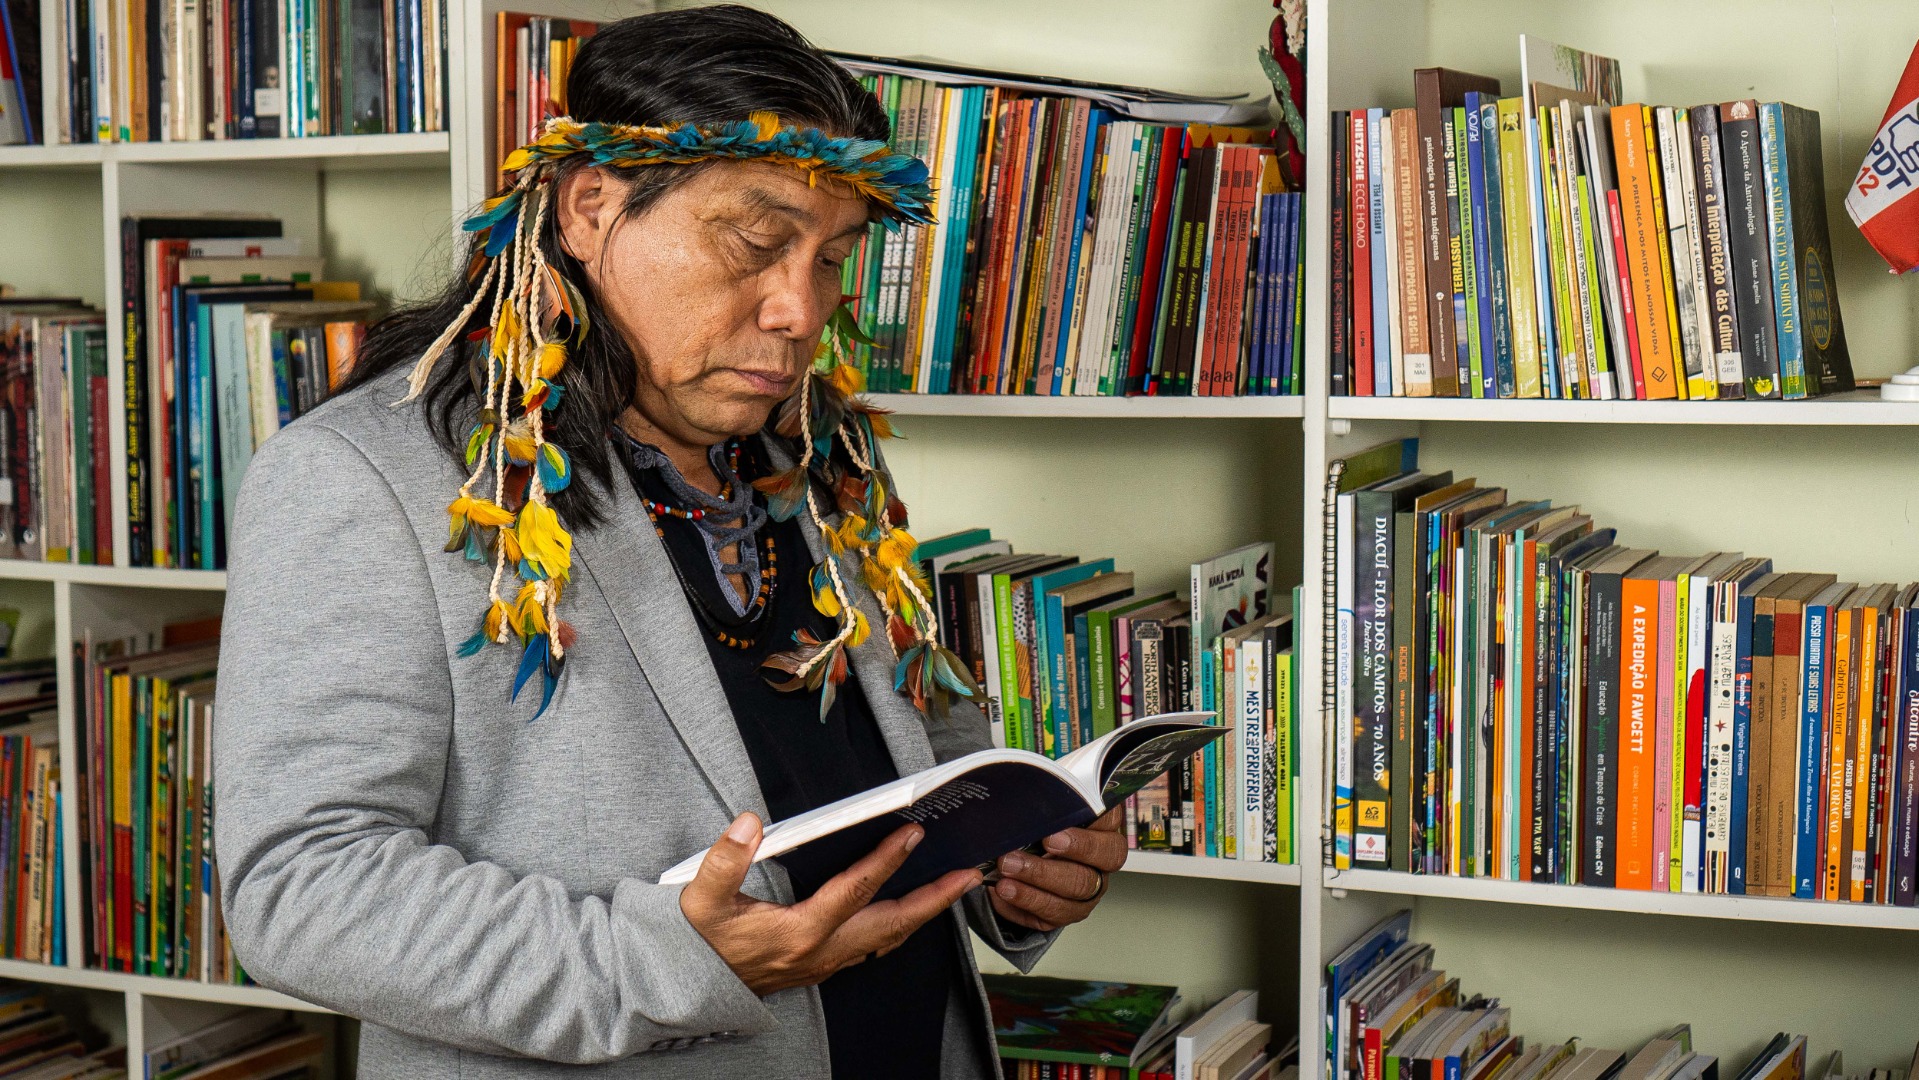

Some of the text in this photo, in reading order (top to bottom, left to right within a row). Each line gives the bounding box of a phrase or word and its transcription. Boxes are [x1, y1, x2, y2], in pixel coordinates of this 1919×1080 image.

[1424, 137, 1437, 181] psicologia
[1443, 122, 1457, 196] HERMAN SCHMITZ
[1623, 119, 1637, 168] Mary Midgley
[1700, 135, 1712, 162] Clifford
[1740, 140, 1751, 169] Apetite
[1703, 164, 1715, 189] Geertz
[1744, 171, 1752, 182] da
[1867, 137, 1912, 191] PDT
[1355, 119, 1365, 248] NIETZSCHE ECCE HOMO
[1401, 167, 1415, 226] INTRODUÇÃO
[1856, 166, 1880, 197] 12
[1130, 202, 1138, 222] ESCOLA
[1428, 190, 1437, 215] povos
[1631, 184, 1643, 227] PRESENÇA
[1705, 194, 1716, 202] a
[1744, 184, 1757, 235] Antropologia
[1772, 186, 1784, 223] PRETAS
[1429, 218, 1442, 261] indígenas
[1638, 230, 1646, 247] DOS
[1704, 206, 1728, 284] Interpretação
[883, 244, 893, 266] BOM
[892, 244, 902, 266] BOM
[904, 244, 914, 266] BOM
[1450, 235, 1463, 293] TERRASSOL
[1641, 250, 1649, 276] MITOS
[1779, 261, 1789, 280] DAS
[1176, 273, 1184, 291] Daniel
[1209, 278, 1217, 300] DANIEL
[1334, 208, 1342, 353] MULHERES SOB DESCONTROLE
[1405, 240, 1417, 312] ANTROPOLOGIA
[1644, 279, 1651, 291] EM
[1751, 259, 1761, 304] Adone Agnolin
[877, 286, 889, 324] MENINO
[885, 286, 896, 324] MENINO
[898, 286, 909, 324] MENINO
[1646, 294, 1656, 326] NOSSAS
[1715, 289, 1731, 312] das
[1779, 283, 1793, 317] ÍNDIOS
[1409, 315, 1419, 349] SOCIAL
[1650, 329, 1659, 355] VIDAS
[1375, 517, 1388, 568] DIACUÍ
[1375, 579, 1386, 617] FLOR
[1375, 621, 1385, 651] DOS
[1811, 616, 1821, 636] PASSA
[1363, 620, 1372, 676] Duclerc Silva
[1810, 638, 1820, 664] QUATRO
[1005, 654, 1013, 680] ALBERT
[1055, 654, 1064, 680] Alencar
[1150, 641, 1160, 716] NORTH AMERICA
[1341, 652, 1350, 686] finitude
[1629, 605, 1648, 754] A EXPEDIÇÃO FAWCETT
[1809, 671, 1819, 688] SUAS
[1007, 682, 1015, 706] BRUCE
[1143, 654, 1153, 717] INDIAN READ
[1374, 653, 1385, 713] CAMPOS
[1598, 681, 1607, 715] Educação
[1739, 674, 1747, 706] Chumbo
[1834, 659, 1847, 737] Gabriela Wiener
[1057, 694, 1067, 710] José
[1246, 691, 1259, 737] MESTRE
[1808, 690, 1818, 713] LETRAS
[1059, 722, 1069, 753] GUARANI
[1374, 724, 1384, 739] 70
[1737, 722, 1745, 748] Virgínia
[1859, 719, 1868, 753] Cabanagem
[1373, 743, 1385, 781] ANOS
[1598, 754, 1604, 765] em
[1246, 746, 1259, 811] PERIFERIAS
[1596, 767, 1605, 795] Tempos
[1596, 806, 1604, 825] Crise
[1597, 796, 1604, 804] de
[1904, 831, 1912, 856] educação
[1595, 860, 1603, 876] CRV
